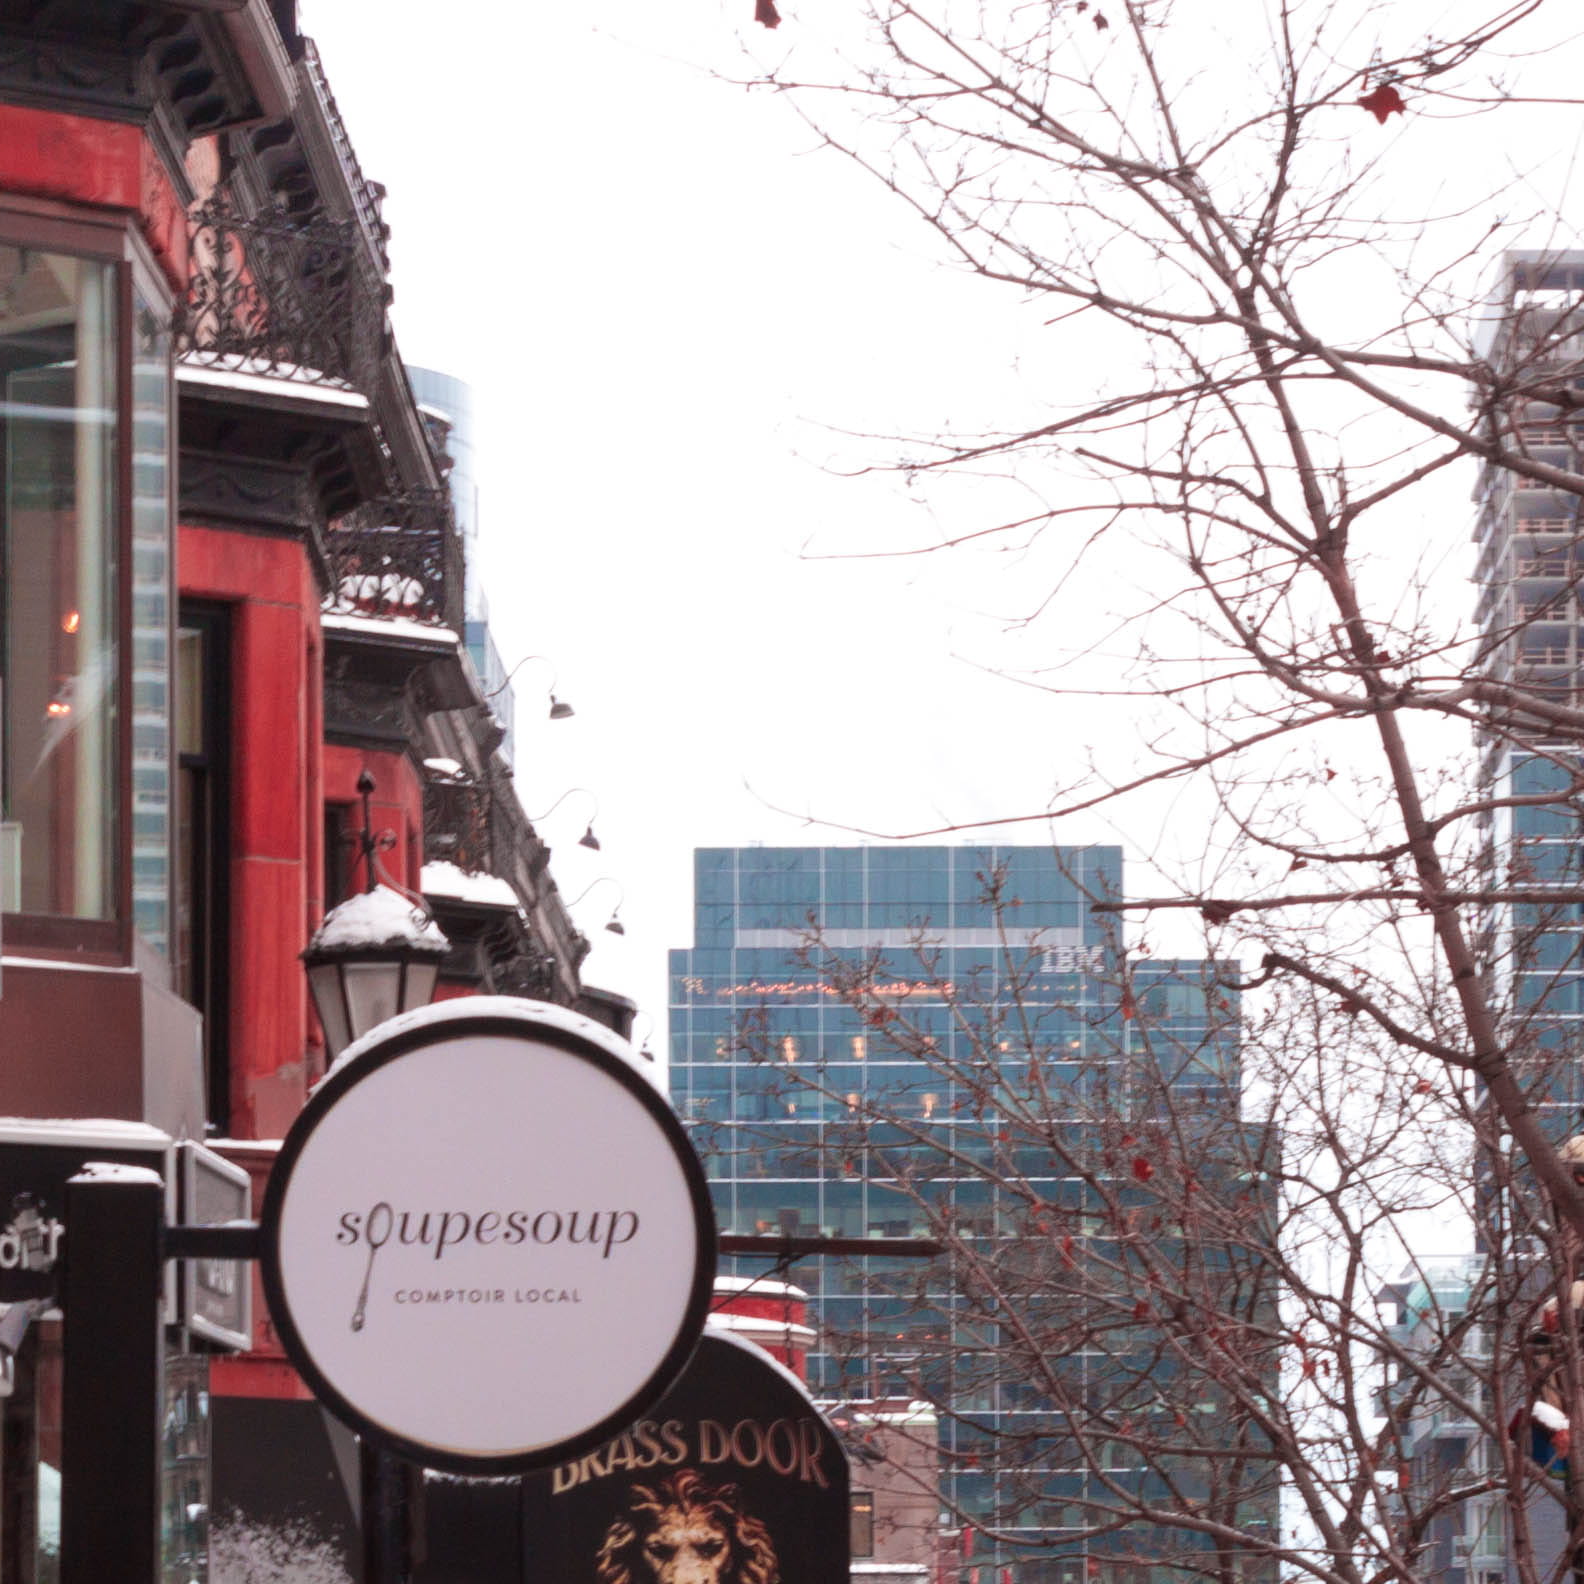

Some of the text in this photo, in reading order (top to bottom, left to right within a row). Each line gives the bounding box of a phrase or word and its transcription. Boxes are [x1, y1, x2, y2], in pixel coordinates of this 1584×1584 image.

[336, 1202, 641, 1260] soupesoup
[395, 1288, 582, 1304] COMPTOIR LOCAL
[700, 1418, 829, 1489] DOOR
